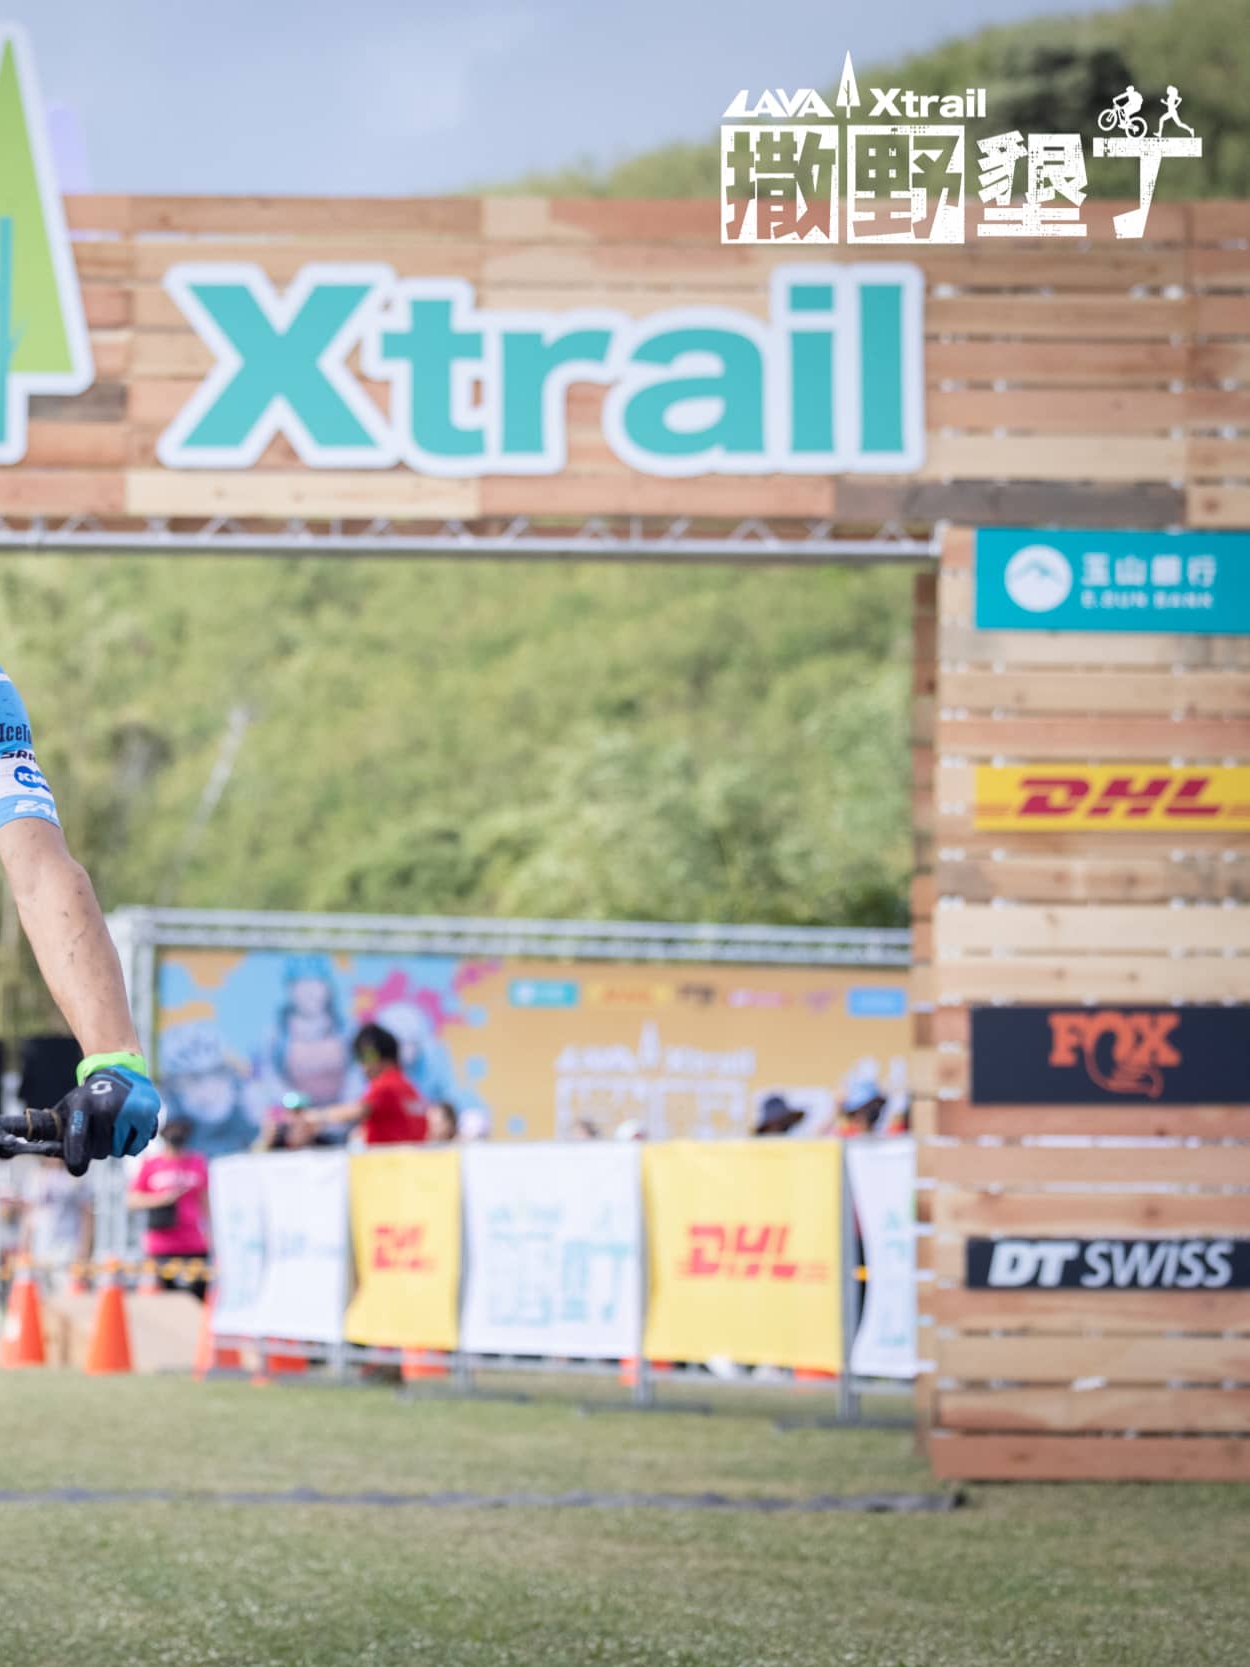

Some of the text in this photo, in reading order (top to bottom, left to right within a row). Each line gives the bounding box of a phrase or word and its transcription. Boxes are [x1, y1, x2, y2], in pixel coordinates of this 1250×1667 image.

[170, 272, 913, 464] Xtrail
[1016, 777, 1222, 817] DHL
[1047, 1010, 1182, 1098] FOX
[986, 1241, 1235, 1288] DT SWISS
